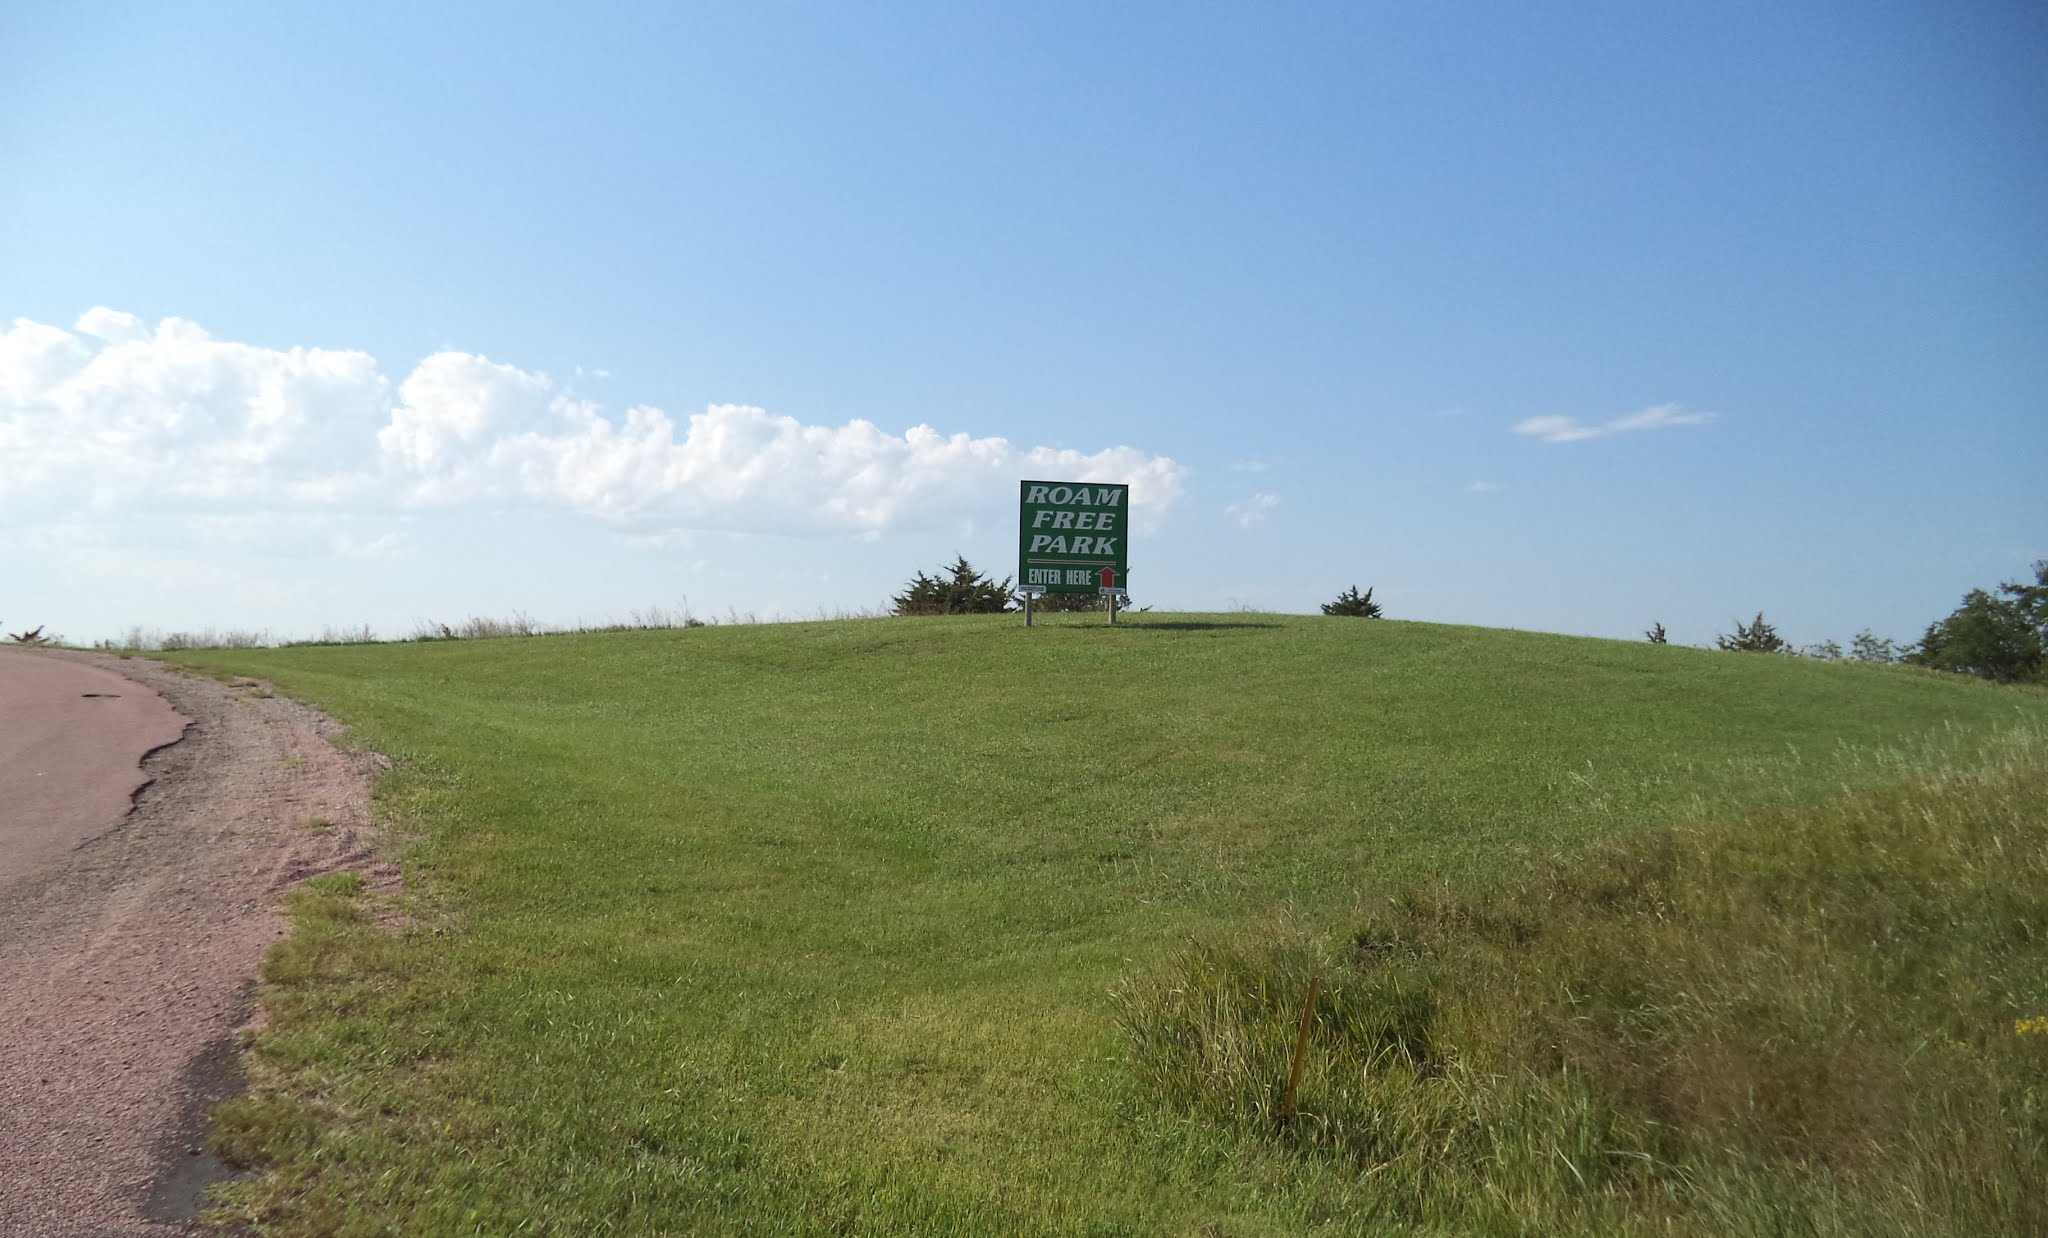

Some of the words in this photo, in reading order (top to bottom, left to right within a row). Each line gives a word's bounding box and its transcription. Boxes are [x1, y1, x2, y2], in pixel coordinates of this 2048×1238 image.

[1025, 485, 1122, 507] ROAM
[1031, 510, 1116, 531] FREE
[1028, 534, 1118, 555] PARK
[1028, 568, 1061, 585] ENTER
[1066, 569, 1092, 586] HERE
